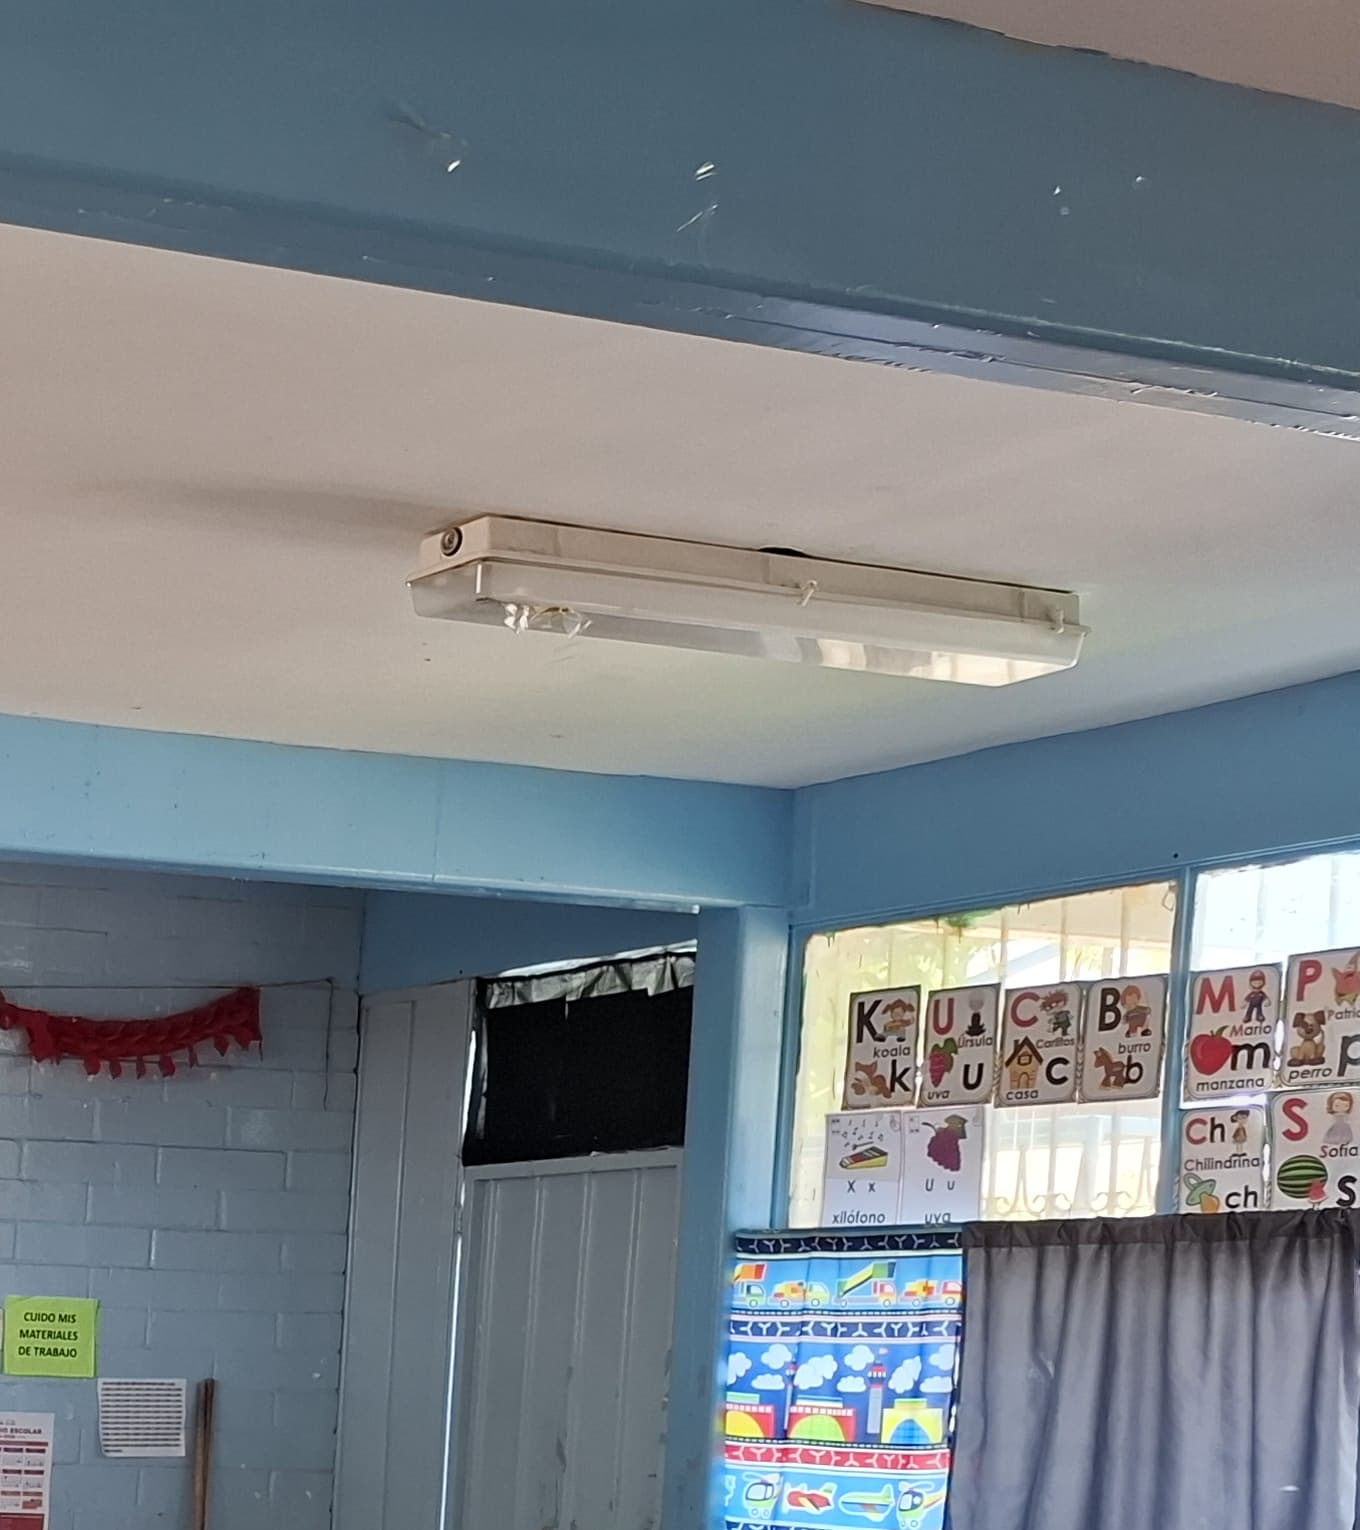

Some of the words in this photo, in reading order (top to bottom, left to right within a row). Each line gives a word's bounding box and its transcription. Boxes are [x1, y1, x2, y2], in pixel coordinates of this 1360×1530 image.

[1296, 959, 1323, 1002] P
[1196, 975, 1236, 1015] M
[932, 997, 954, 1035] U
[1011, 992, 1039, 1028] C
[1098, 987, 1121, 1032] B
[856, 999, 882, 1044] K
[1230, 1021, 1272, 1037] Mario
[873, 1045, 911, 1058] koala
[957, 1035, 993, 1050] Úrsula
[1118, 1042, 1151, 1055] burro
[1231, 1041, 1271, 1072] m
[1124, 1056, 1143, 1085] b
[1287, 1066, 1333, 1083] perro
[1196, 1076, 1265, 1092] manzana
[927, 1089, 950, 1101] uva
[1006, 1089, 1039, 1101] casa
[1282, 1097, 1310, 1142] S
[1185, 1116, 1226, 1146] Ch
[1184, 1153, 1261, 1172] Chilindrina
[1225, 1185, 1259, 1210] ch
[832, 1211, 886, 1225] xilófono
[24, 1312, 56, 1323] CUIDO
[58, 1313, 77, 1324] MIS
[19, 1329, 79, 1341] MATERIALES
[18, 1346, 30, 1357] DE
[34, 1346, 77, 1358] TRABAJO
